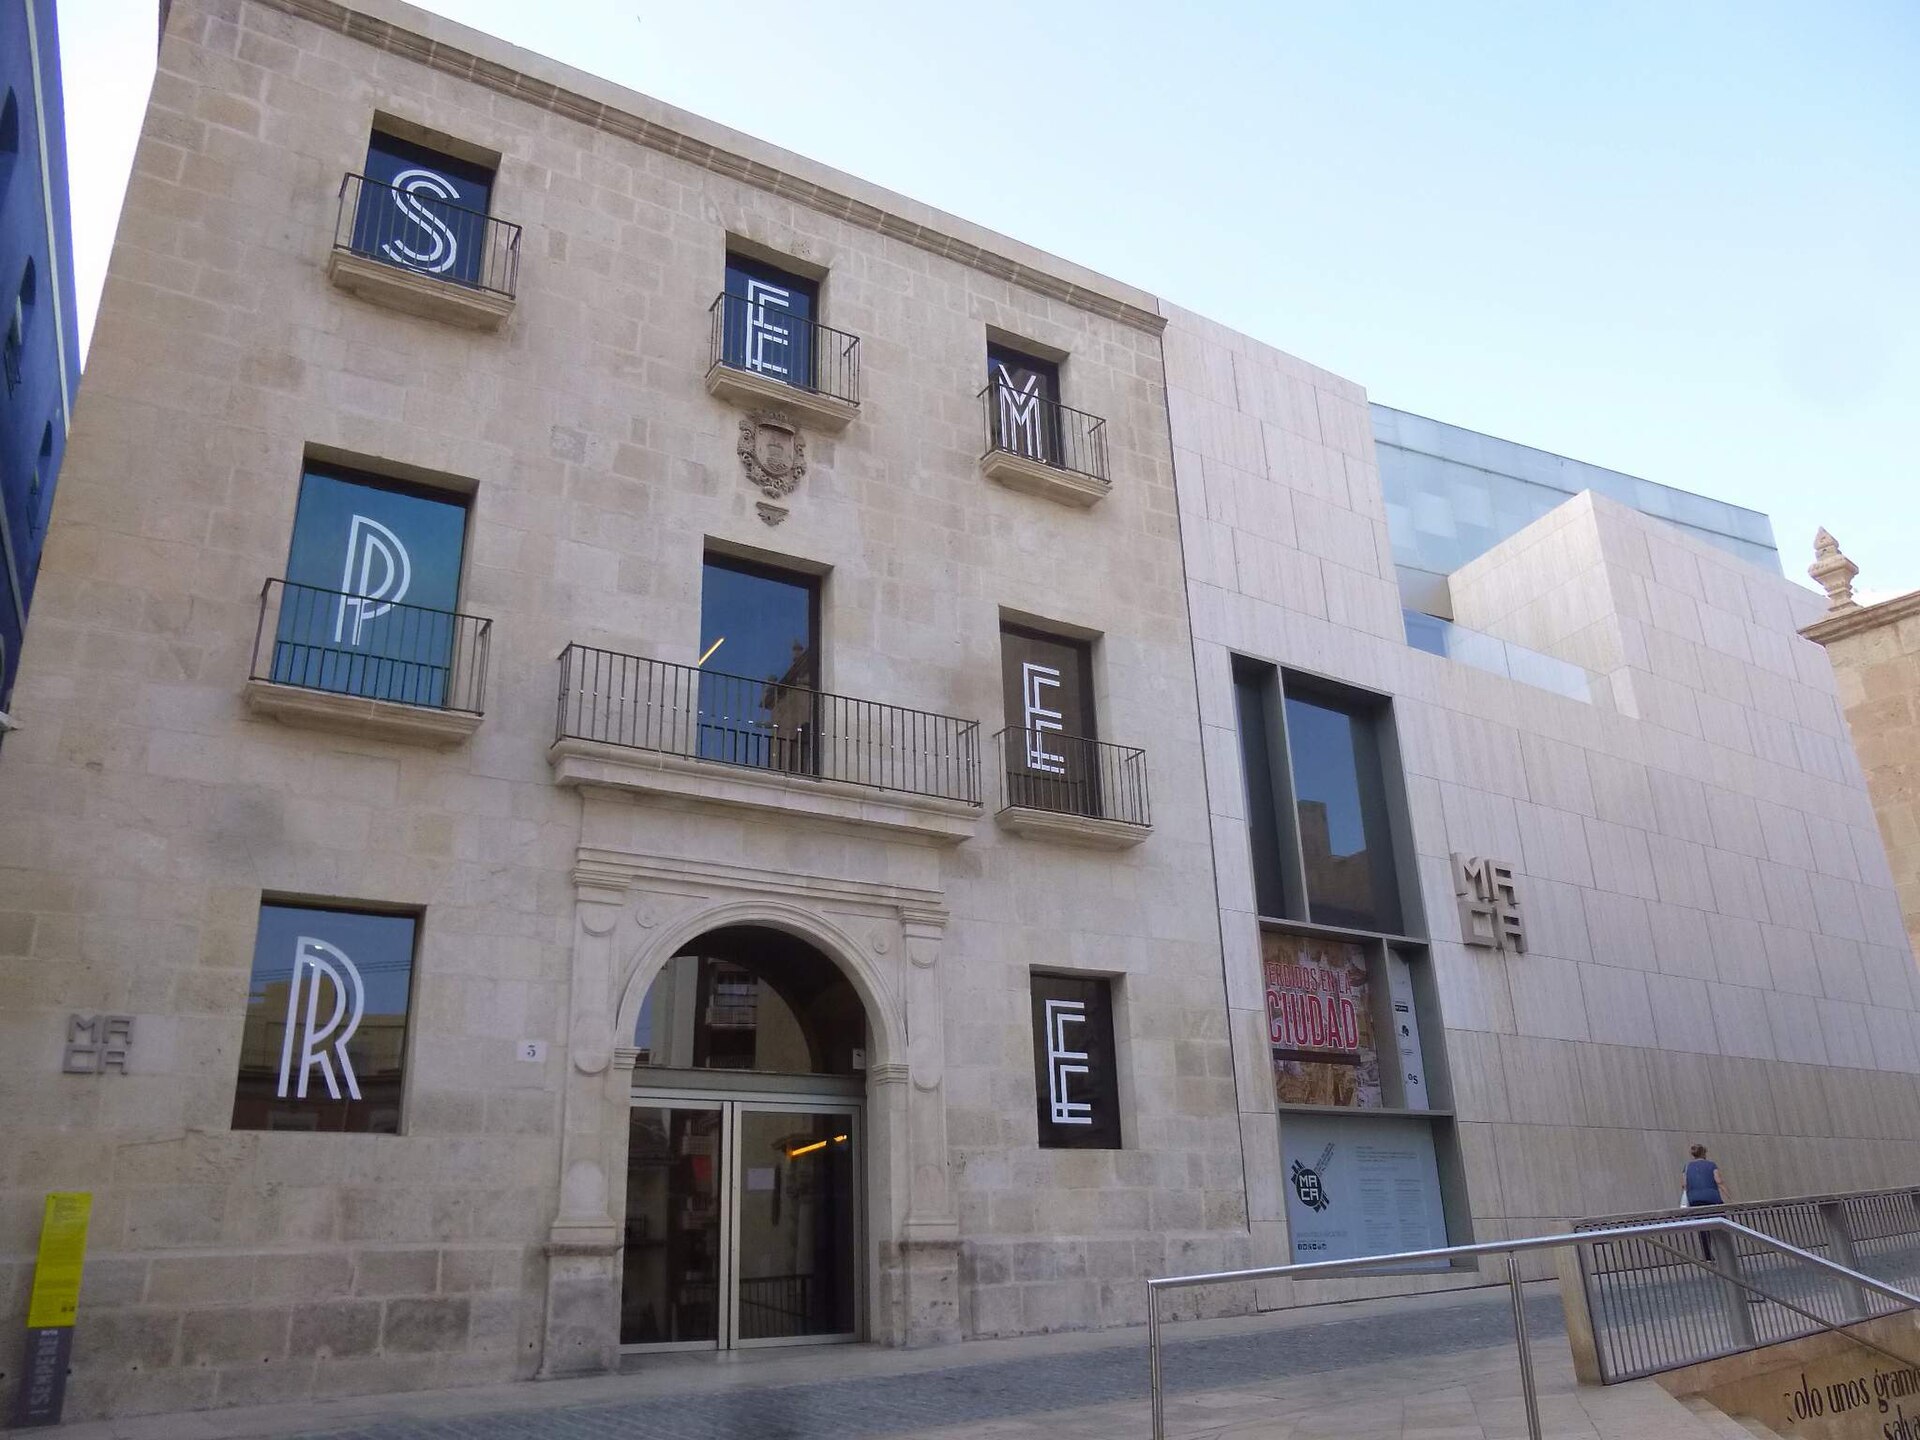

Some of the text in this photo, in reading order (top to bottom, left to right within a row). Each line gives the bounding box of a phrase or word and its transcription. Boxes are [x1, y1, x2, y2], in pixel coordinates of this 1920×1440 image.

[382, 168, 460, 274] S
[745, 279, 790, 384] E
[998, 364, 1047, 462] M
[333, 514, 411, 646] P
[1022, 662, 1065, 774] E
[277, 935, 365, 1100] R
[1266, 989, 1359, 1050] CIUDAD
[1320, 968, 1334, 992] EN
[1045, 999, 1092, 1125] E
[1784, 1373, 1824, 1424] olo
[1826, 1377, 1871, 1414] unos
